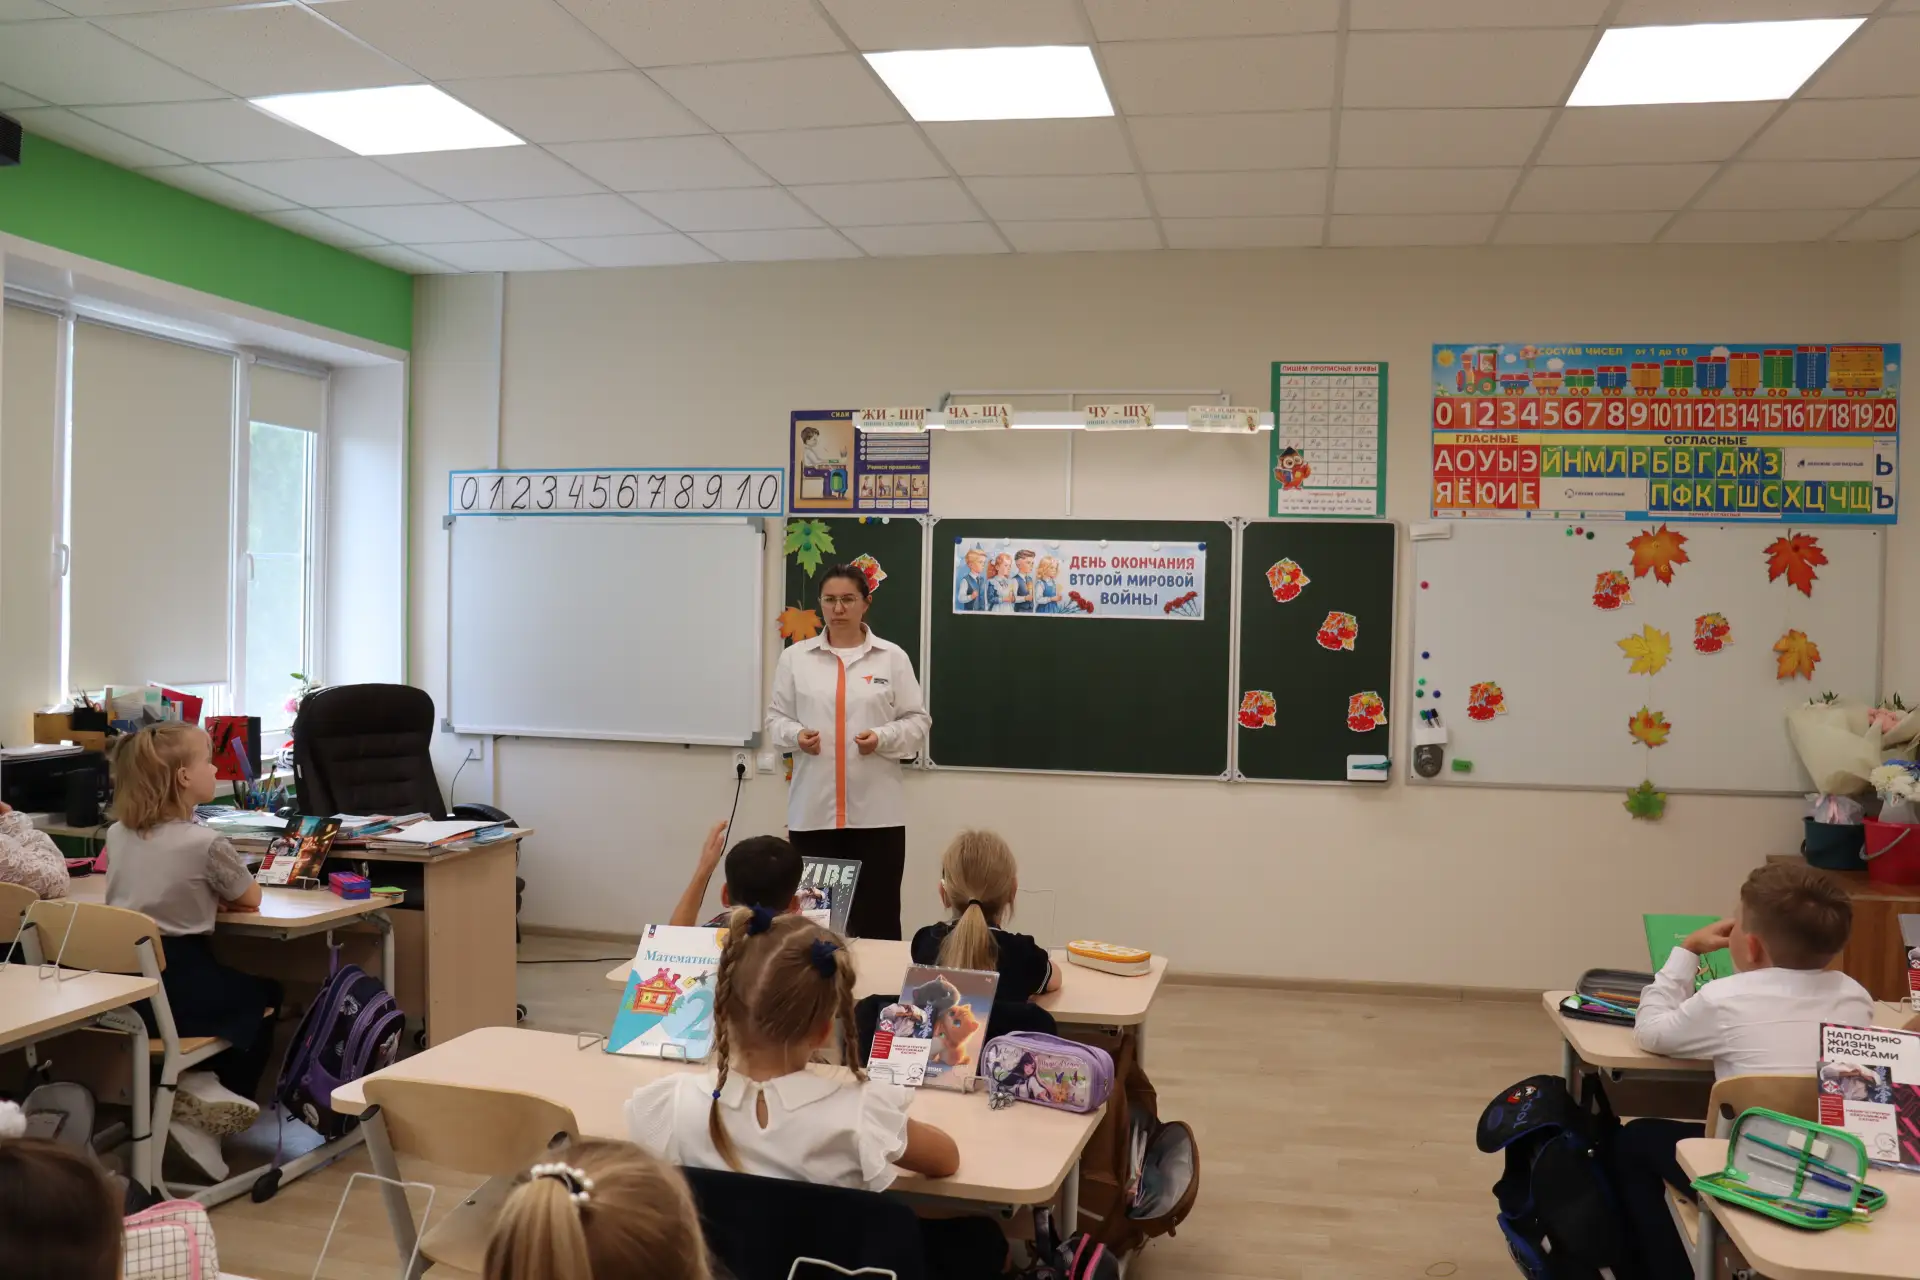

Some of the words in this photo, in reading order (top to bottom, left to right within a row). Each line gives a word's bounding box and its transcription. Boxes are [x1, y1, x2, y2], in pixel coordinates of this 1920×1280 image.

[1539, 347, 1582, 356] СОСТАВ
[1586, 347, 1623, 356] ЧИСЕЛ
[1659, 348, 1672, 357] до
[1676, 347, 1688, 356] 10
[862, 408, 886, 420] ЖИ
[899, 408, 925, 420] ШИ
[948, 406, 970, 418] ЧА
[982, 405, 1008, 418] ЩА
[1088, 406, 1110, 418] ЧУ
[1123, 405, 1151, 418] ЩУ
[1436, 402, 1453, 425] 0
[1460, 402, 1471, 425] 1
[1478, 402, 1495, 425] 2
[1500, 402, 1517, 425] 3
[1520, 402, 1539, 426] 4
[1543, 403, 1560, 426] 5
[1564, 403, 1582, 426] 6
[1585, 403, 1603, 426] 7
[1607, 403, 1625, 426] 8
[1630, 403, 1648, 426] 9
[1651, 403, 1671, 426] 10
[1673, 403, 1692, 427] 11
[1694, 403, 1715, 427] 12
[1716, 404, 1737, 427] 13
[1739, 404, 1759, 427] 14
[1761, 404, 1782, 427] 15
[1783, 404, 1805, 427] 16
[1806, 404, 1827, 428] 17
[1828, 404, 1849, 428] 18
[1851, 404, 1873, 428] 19
[1874, 404, 1896, 428] 20
[1456, 434, 1518, 444] ГЛАСНЫЕ
[1664, 435, 1748, 446] СОГЛАСНЫЕ
[1434, 450, 1454, 472] А
[1456, 450, 1475, 472] О
[1477, 450, 1496, 472] У
[1499, 450, 1517, 472] Ы
[1521, 450, 1538, 472] Э
[1543, 447, 1560, 473] Й
[1564, 452, 1582, 473] Н
[1584, 452, 1605, 473] М
[1606, 452, 1626, 473] Л
[1631, 452, 1647, 473] Р
[1653, 452, 1669, 473] Б
[1674, 452, 1691, 473] В
[1699, 452, 1712, 473] Г
[1717, 452, 1737, 476] Д
[1739, 452, 1760, 473] Ж
[1764, 452, 1779, 473] З
[1876, 454, 1894, 476] Ь
[460, 477, 478, 510] 0
[489, 477, 503, 510] 1
[511, 477, 531, 510] 2
[537, 476, 557, 510] 3
[568, 476, 584, 510] 4
[589, 476, 611, 510] 5
[616, 476, 637, 509] 6
[647, 476, 666, 509] 7
[674, 475, 694, 509] 8
[702, 475, 723, 509] 9
[736, 475, 778, 509] 10
[1436, 482, 1452, 504] Я
[1459, 478, 1472, 504] Ё
[1476, 482, 1496, 504] Ю
[1500, 482, 1517, 504] И
[1523, 482, 1536, 504] Е
[1652, 485, 1669, 507] П
[1672, 485, 1692, 507] Ф
[1696, 485, 1711, 507] К
[1718, 485, 1735, 507] Т
[1739, 485, 1758, 507] Ш
[1763, 485, 1780, 507] С
[1785, 485, 1801, 507] Х
[1806, 486, 1825, 511] Ц
[1830, 485, 1847, 507] Ч
[1851, 486, 1871, 511] Щ
[1874, 487, 1894, 509] Ъ
[1069, 555, 1107, 570] ДЕНЬ
[1111, 556, 1195, 570] ОКОНЧАНИЯ
[1069, 571, 1122, 587] ВТОРОЙ
[1127, 572, 1194, 587] МИРОВОЙ
[1100, 588, 1158, 606] ВОЙНЫ
[644, 949, 721, 965] Математика
[675, 989, 714, 1040] 2
[1827, 1030, 1902, 1045] НАПОЛНЯЮ
[1827, 1038, 1876, 1050] ЖИЗНЬ
[1827, 1046, 1899, 1061] КРАСКАМИ
